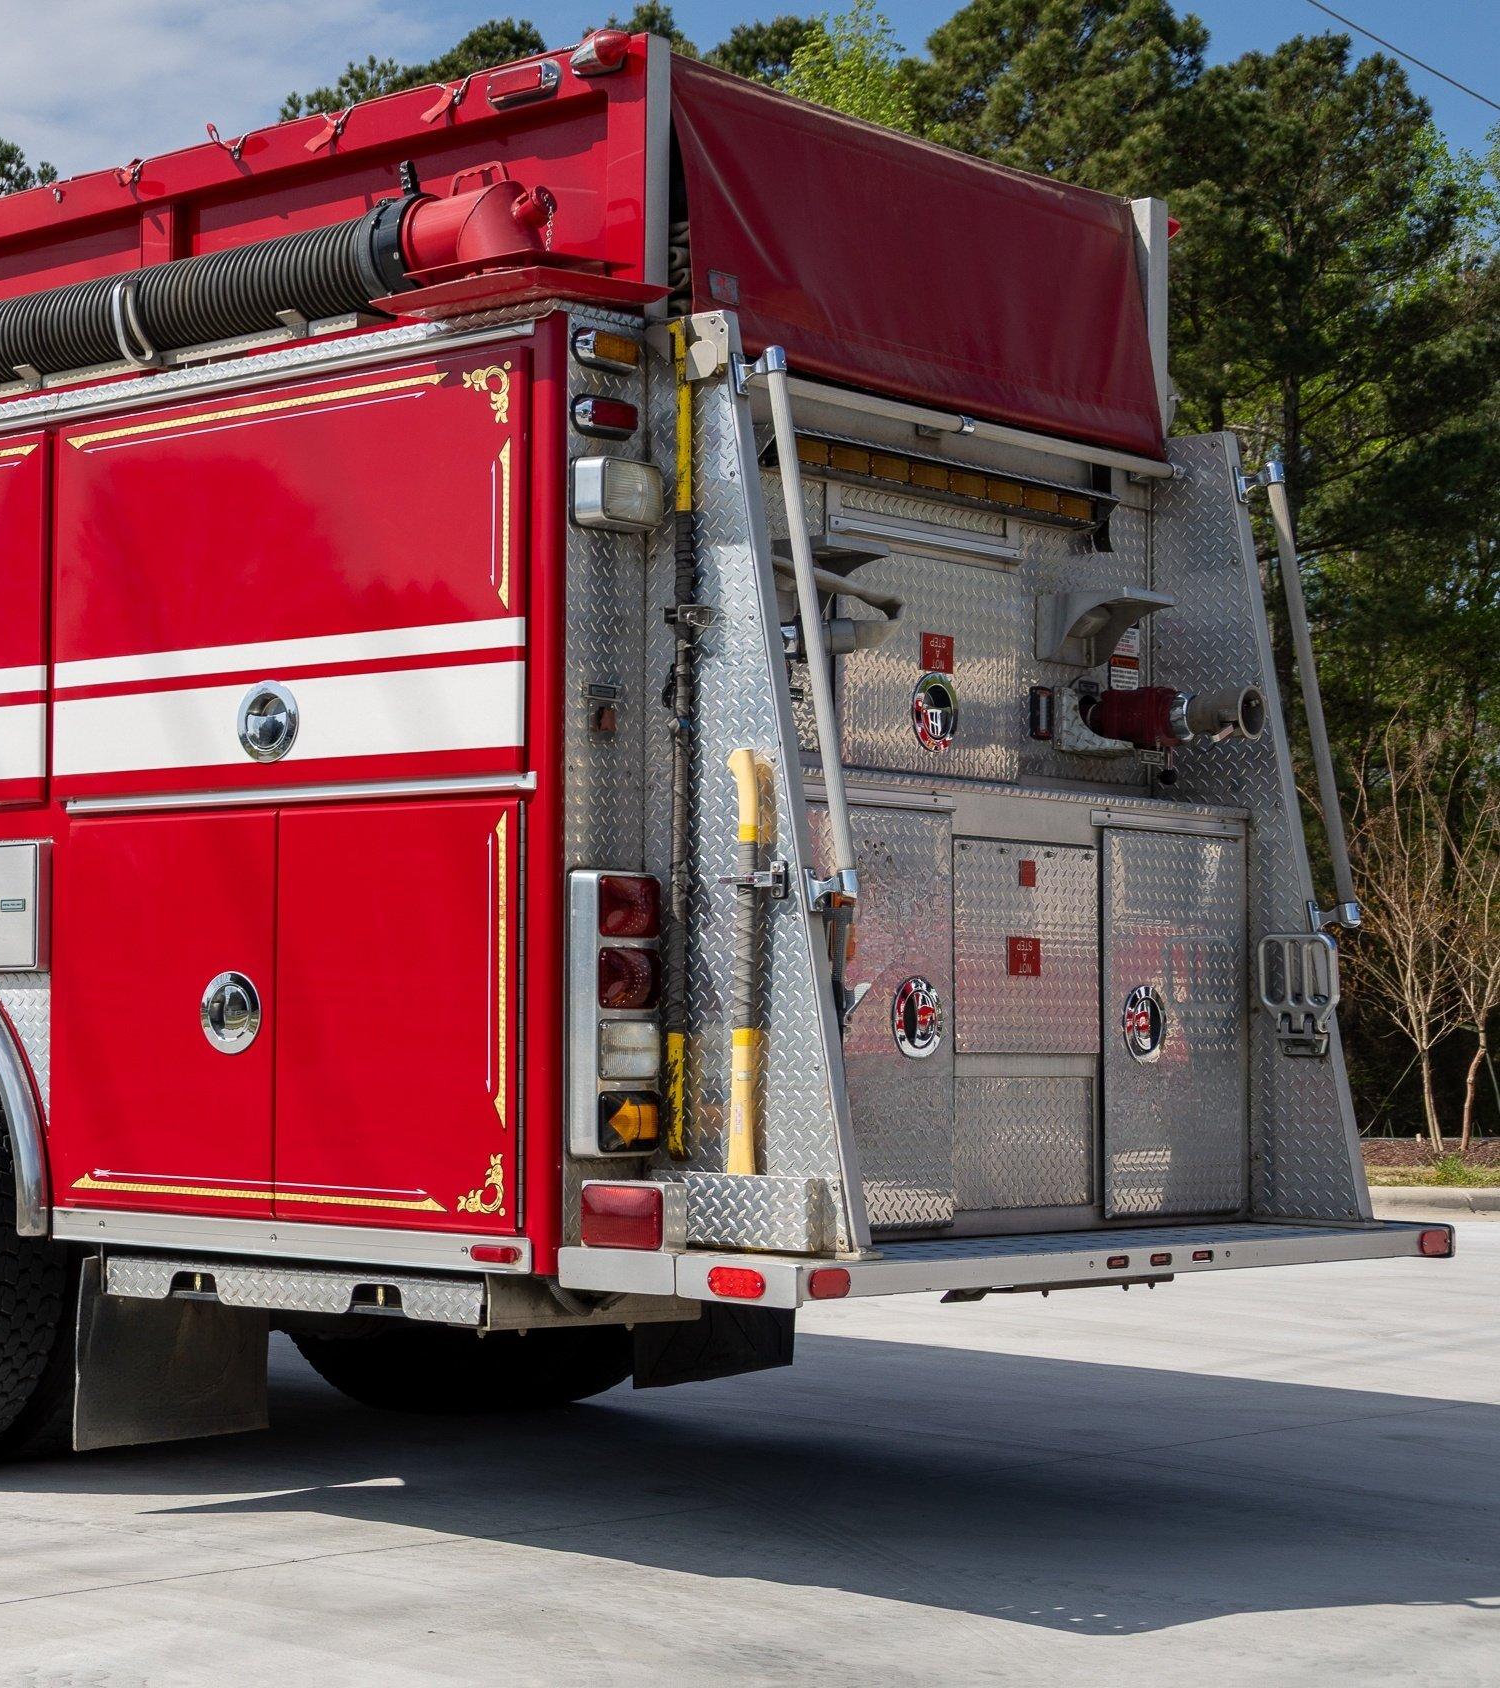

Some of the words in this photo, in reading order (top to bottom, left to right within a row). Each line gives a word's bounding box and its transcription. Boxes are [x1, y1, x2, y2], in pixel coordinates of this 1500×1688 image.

[930, 637, 947, 649] STEP
[931, 659, 945, 670] NOT
[1016, 941, 1033, 951] STEP
[1018, 963, 1032, 974] NOT
